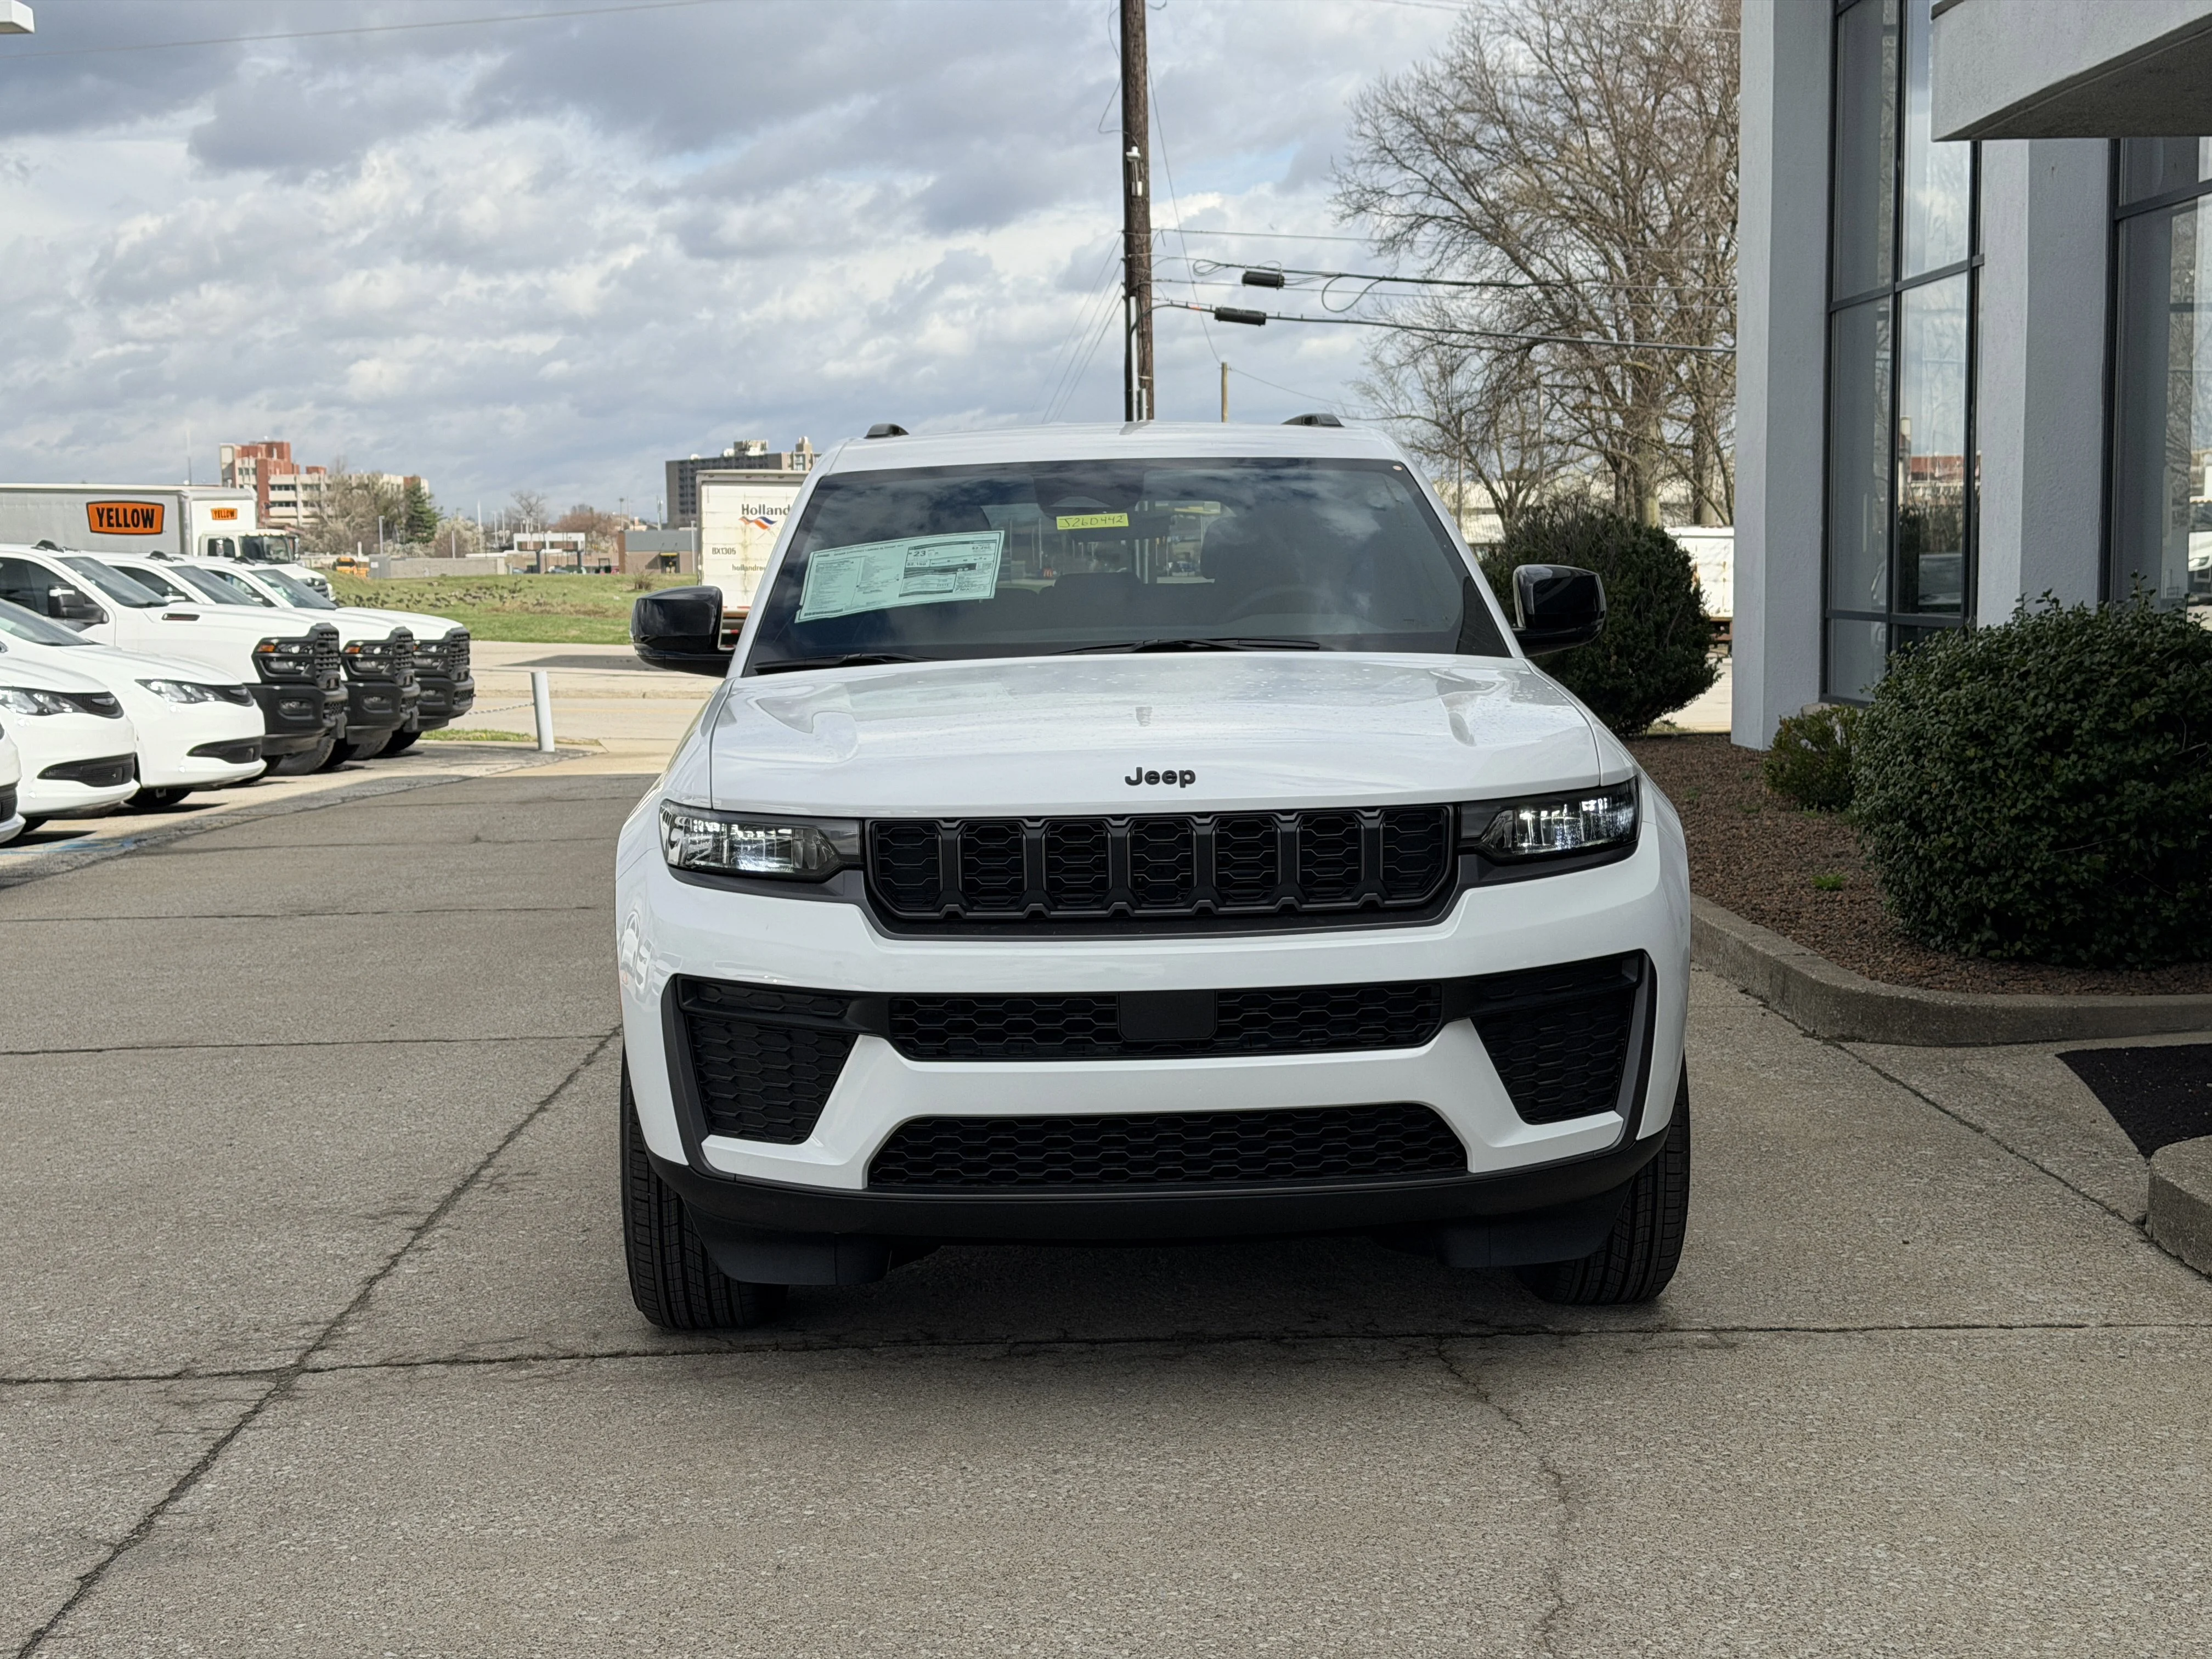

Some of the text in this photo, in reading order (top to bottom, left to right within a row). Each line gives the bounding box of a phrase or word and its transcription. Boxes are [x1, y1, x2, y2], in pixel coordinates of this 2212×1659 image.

[96, 507, 155, 528] YELLOW
[214, 510, 235, 518] YELLOW
[741, 504, 790, 516] Holland
[1125, 767, 1195, 788] Jeep
